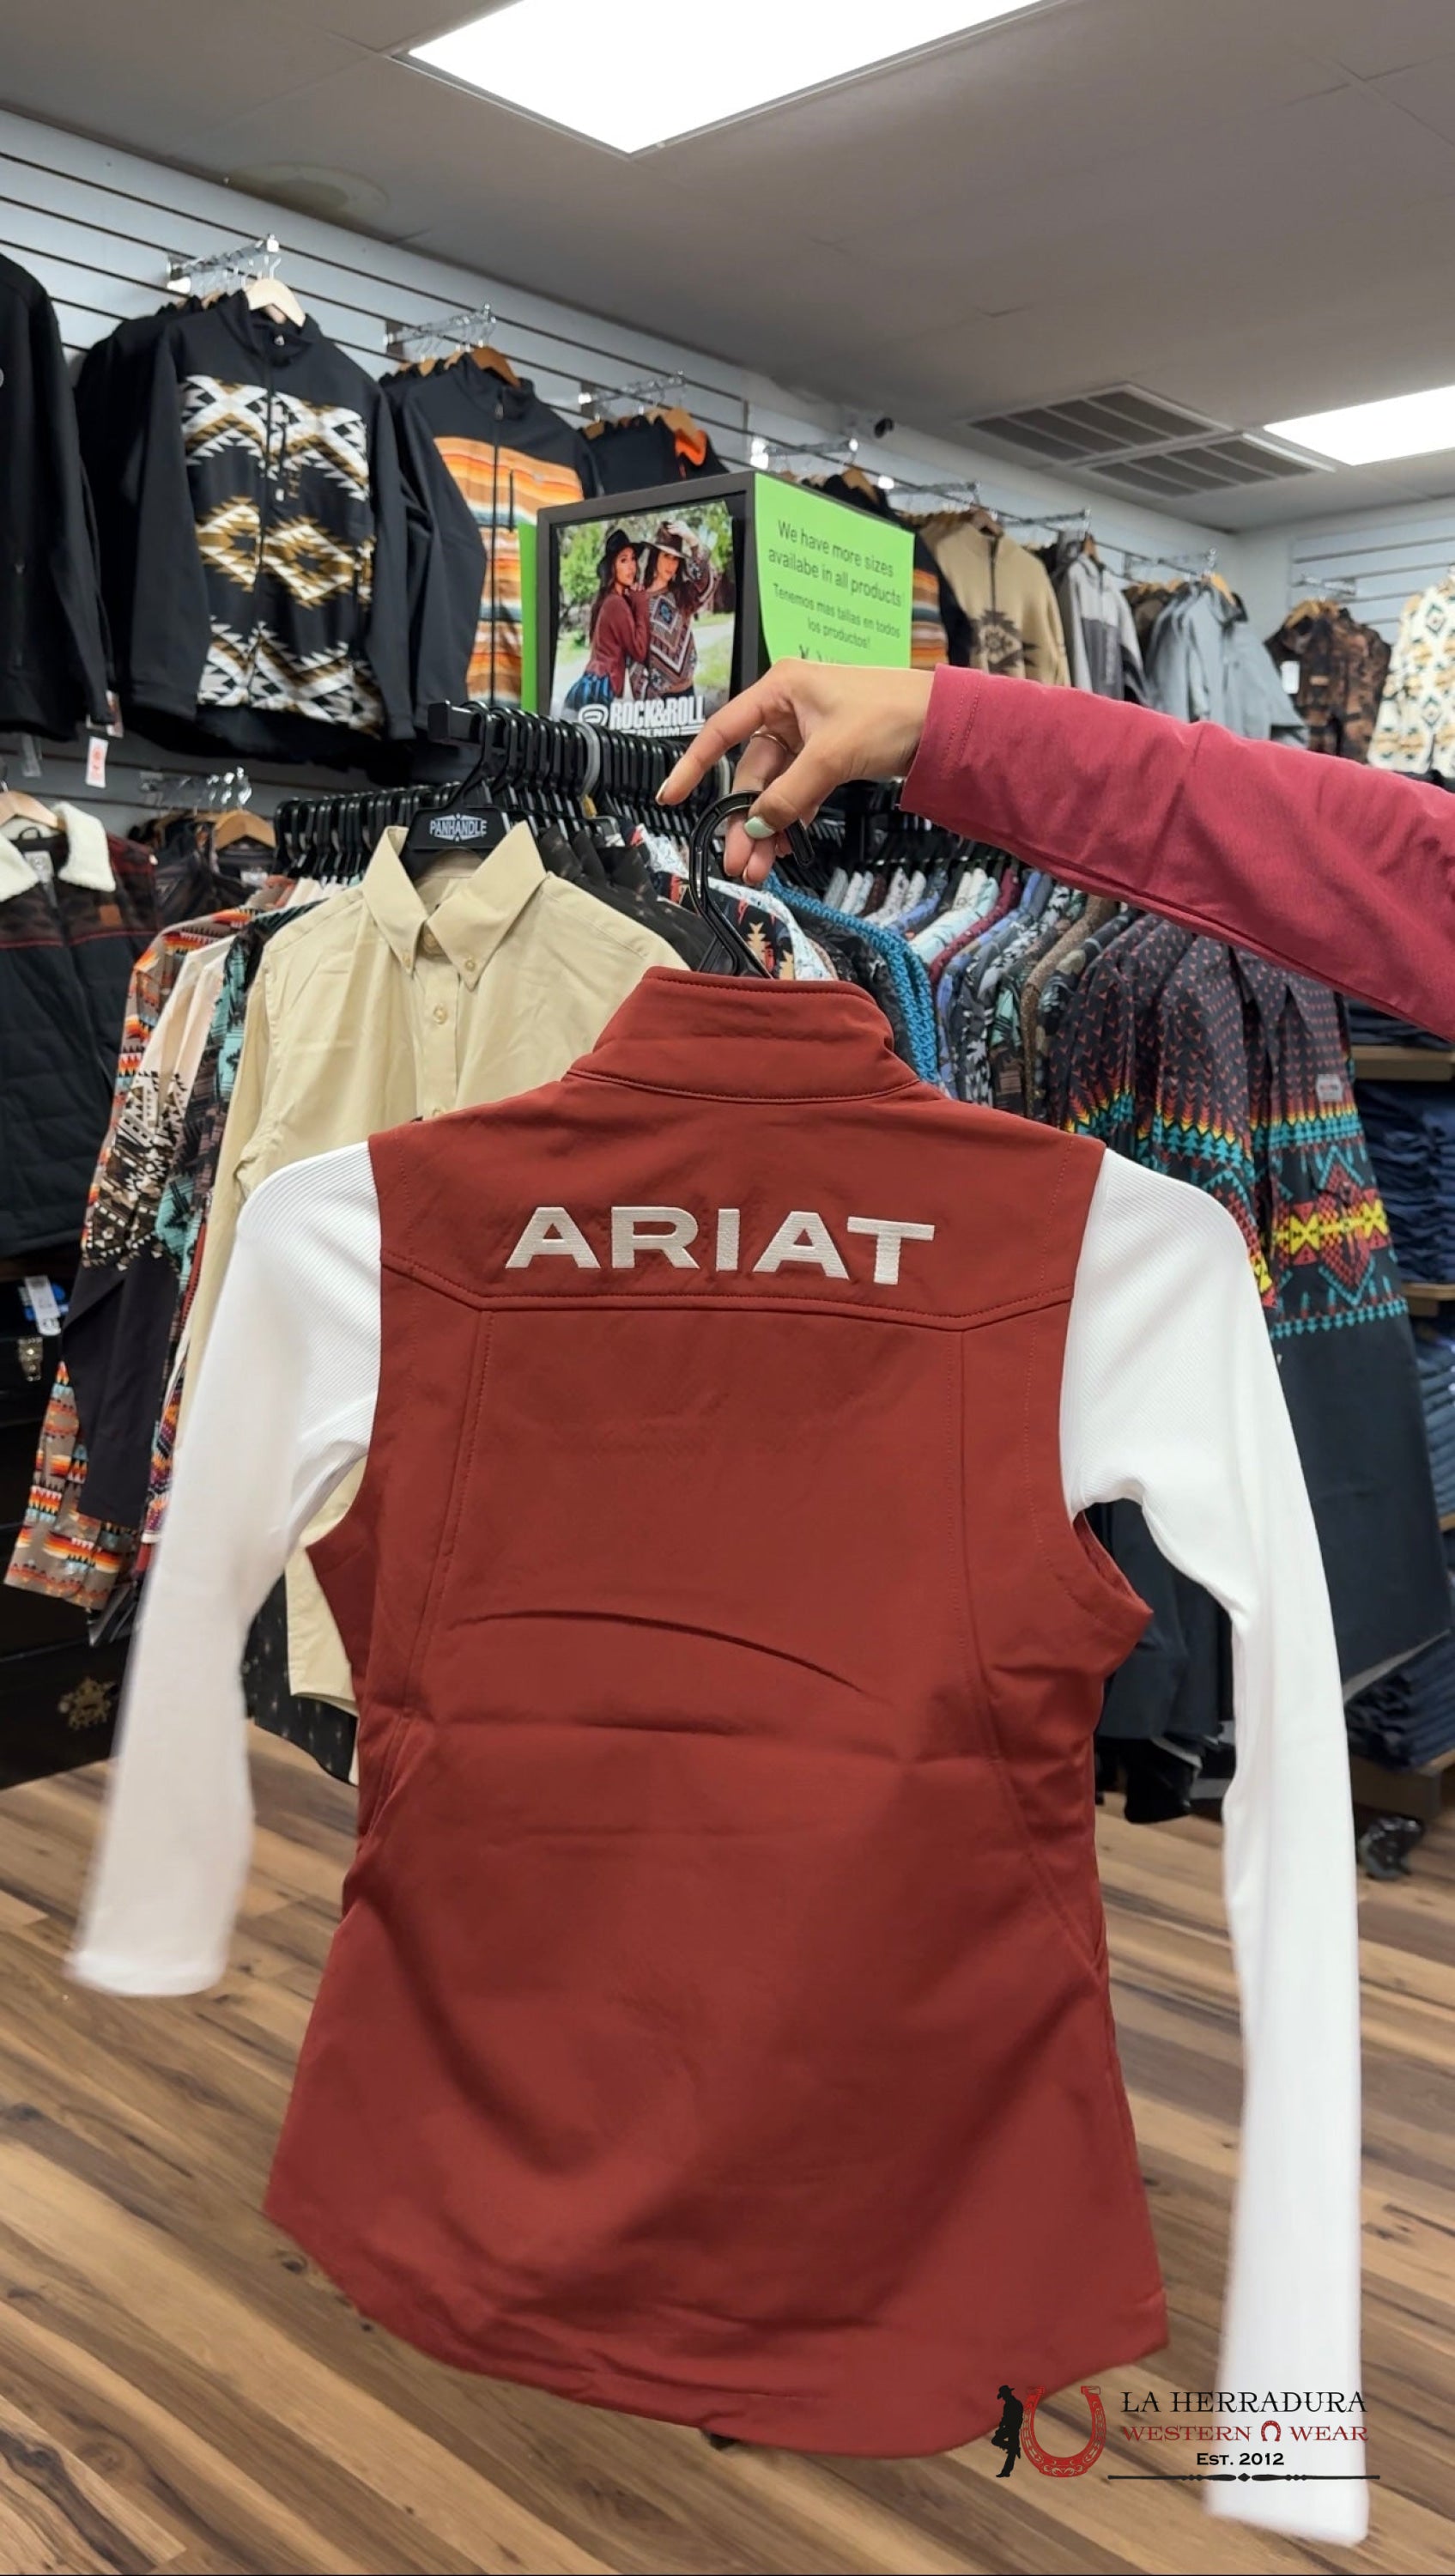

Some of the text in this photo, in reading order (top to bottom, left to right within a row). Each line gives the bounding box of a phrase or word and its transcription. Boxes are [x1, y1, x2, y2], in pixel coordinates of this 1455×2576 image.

[768, 548, 819, 578] availabe
[821, 563, 833, 583] in
[834, 571, 849, 588] all
[778, 519, 894, 578] We have more sizes
[773, 582, 815, 611] Tenemos
[837, 606, 861, 625] tallas
[863, 617, 874, 629] en
[876, 618, 900, 639] todos
[807, 617, 821, 635] los
[609, 696, 706, 731] ROCK&ROLL
[429, 818, 488, 835] PANHANDLE
[505, 1206, 936, 1285] ARIAT
